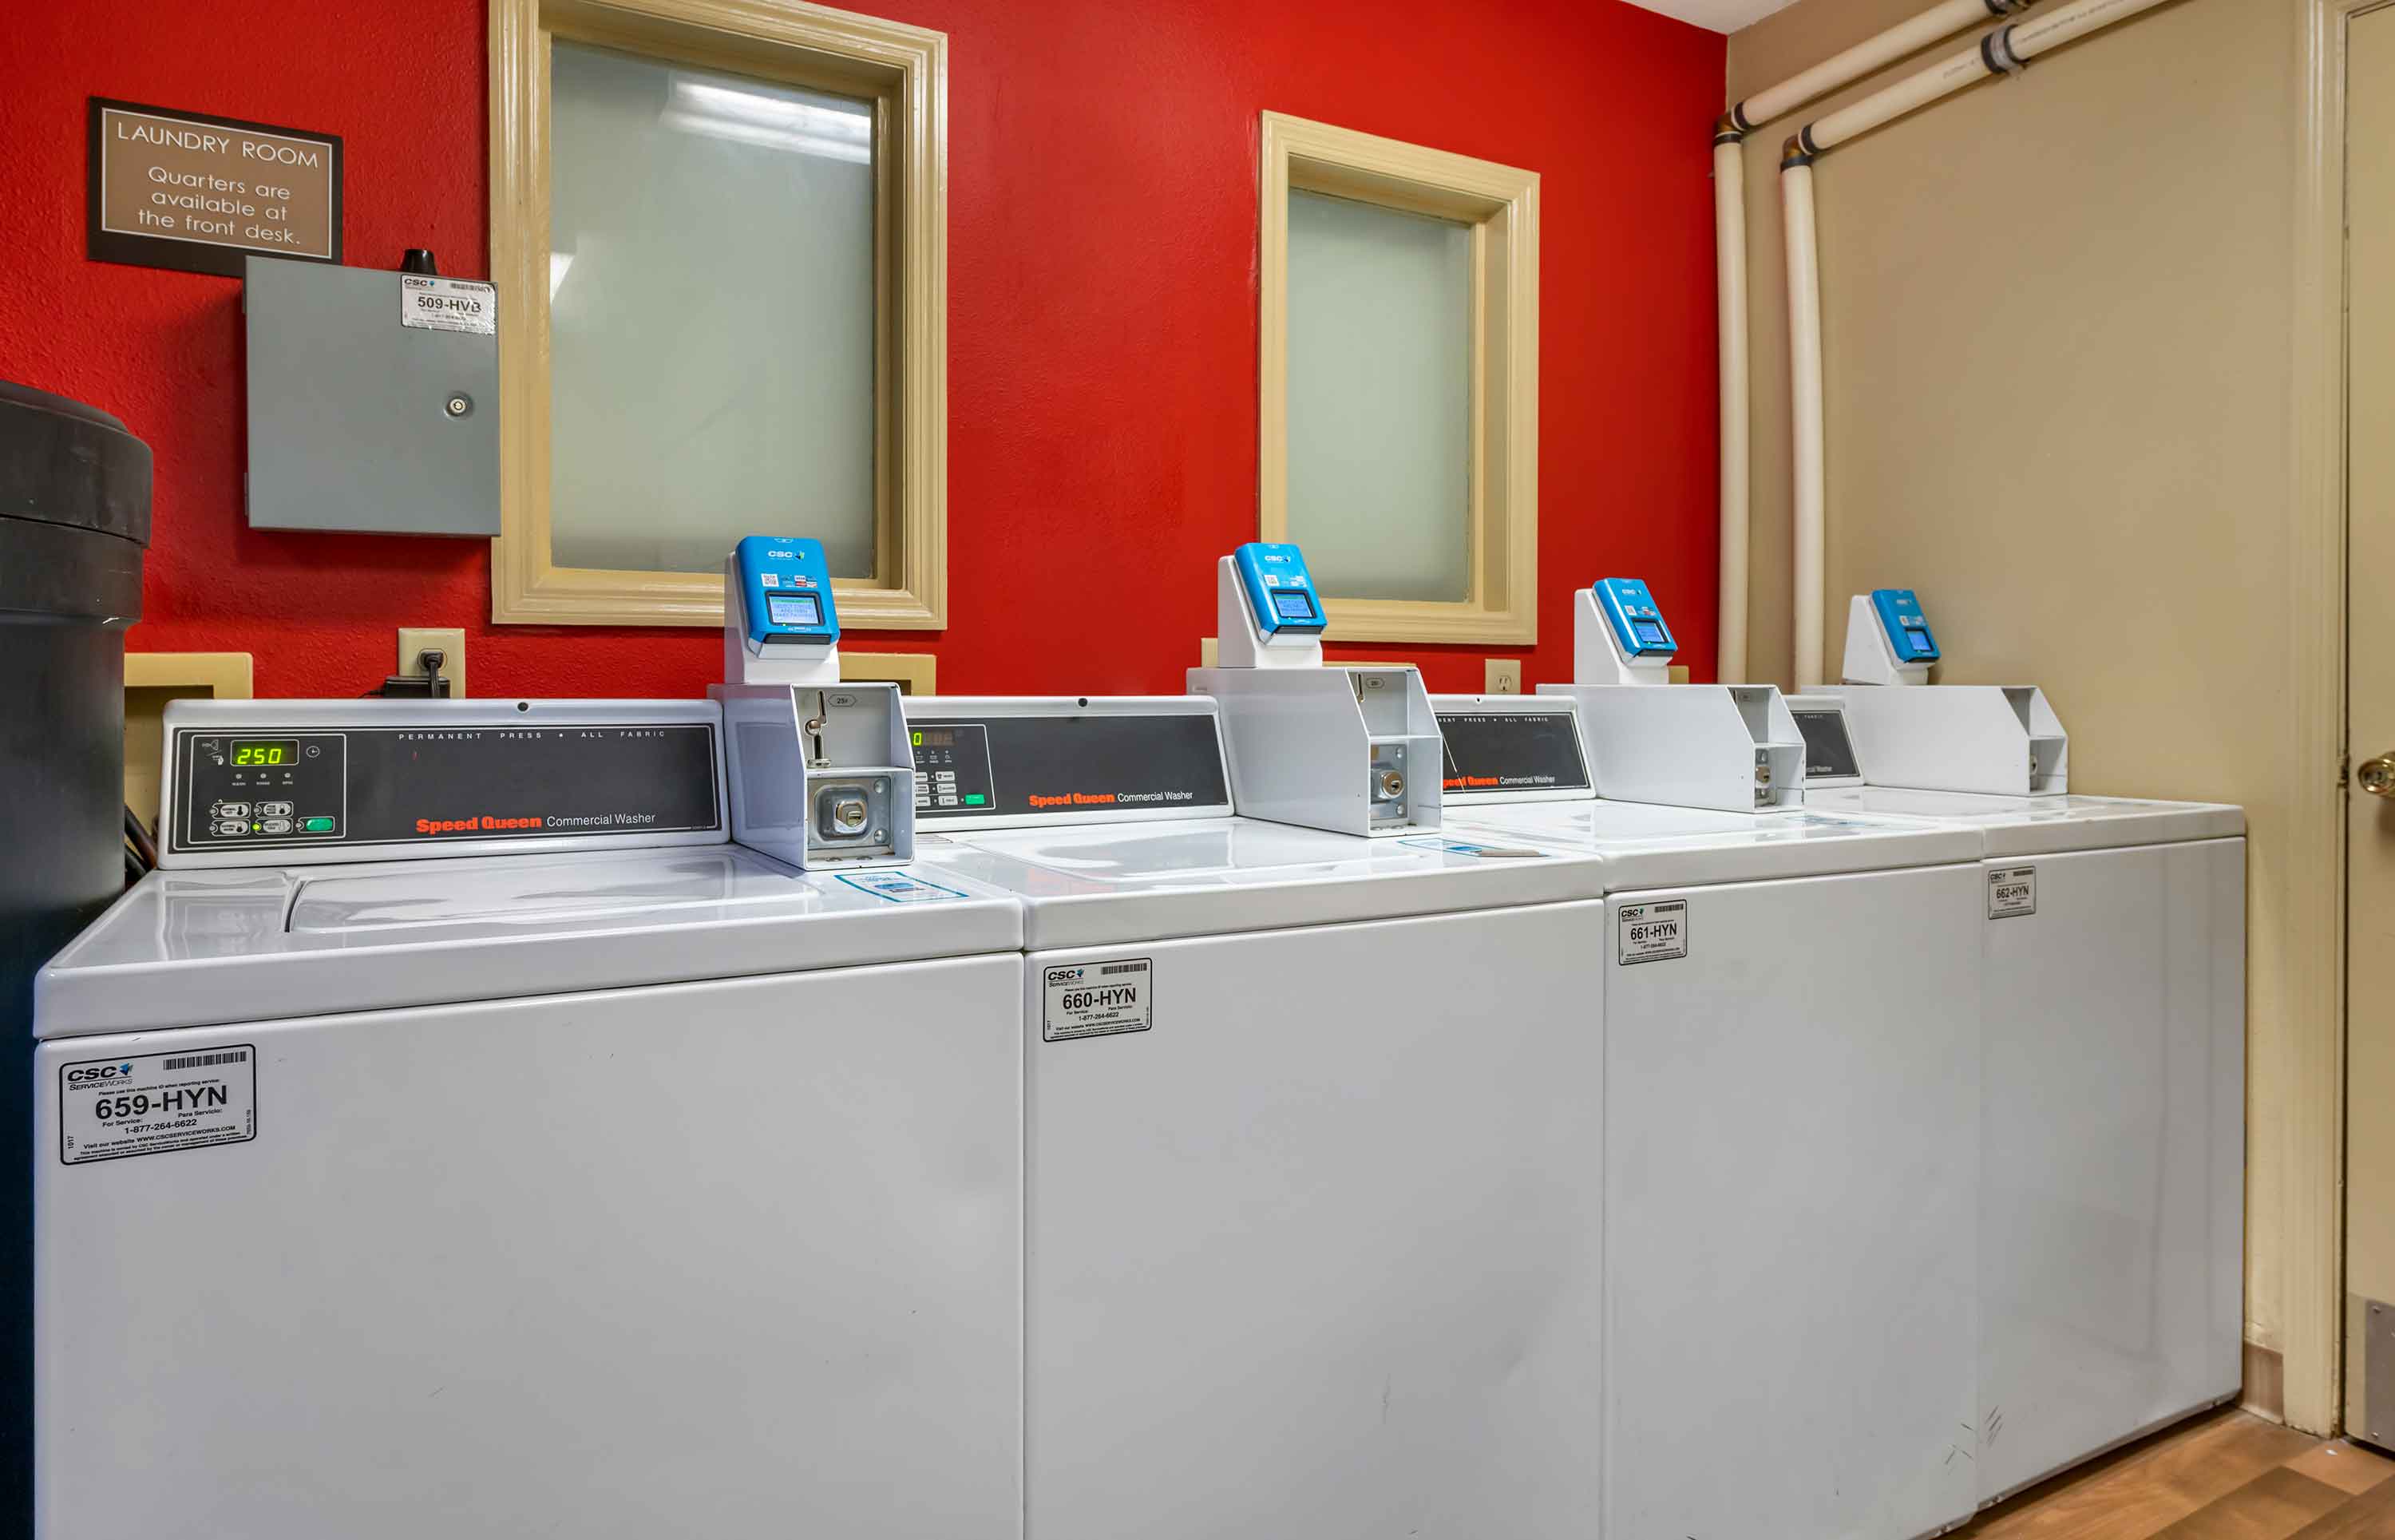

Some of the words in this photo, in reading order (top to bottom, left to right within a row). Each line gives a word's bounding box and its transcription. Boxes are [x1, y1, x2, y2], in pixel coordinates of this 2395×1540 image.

[117, 121, 229, 156] LAUNDRY
[243, 141, 318, 168] ROOM
[148, 166, 245, 194] Quarters
[255, 184, 290, 200] are
[152, 191, 255, 217] available
[266, 206, 287, 221] at
[139, 208, 174, 228] the
[185, 216, 236, 237] front
[245, 224, 300, 245] desk.
[237, 748, 282, 765] 250
[1443, 777, 1467, 789] peed
[1500, 776, 1533, 785] Commercial
[1533, 775, 1555, 784] Washer
[1029, 794, 1071, 809] Speed
[1074, 793, 1114, 804] Queen
[1118, 791, 1163, 802] Commercial
[1164, 790, 1193, 800] Washer
[416, 817, 478, 834] Speed
[481, 816, 542, 829] Queen
[547, 814, 612, 827] Commercial
[615, 813, 655, 825] Washer
[1997, 885, 2029, 899] 662-HYN
[1621, 909, 1639, 917] CSC
[1630, 923, 1677, 940] 661-HYN
[1048, 970, 1075, 980] CSC
[1063, 988, 1136, 1009] 660-HYN
[67, 1067, 117, 1082] CSC
[96, 1085, 227, 1119] 659-HYN
[125, 1118, 197, 1134] 1-877-264-6622
